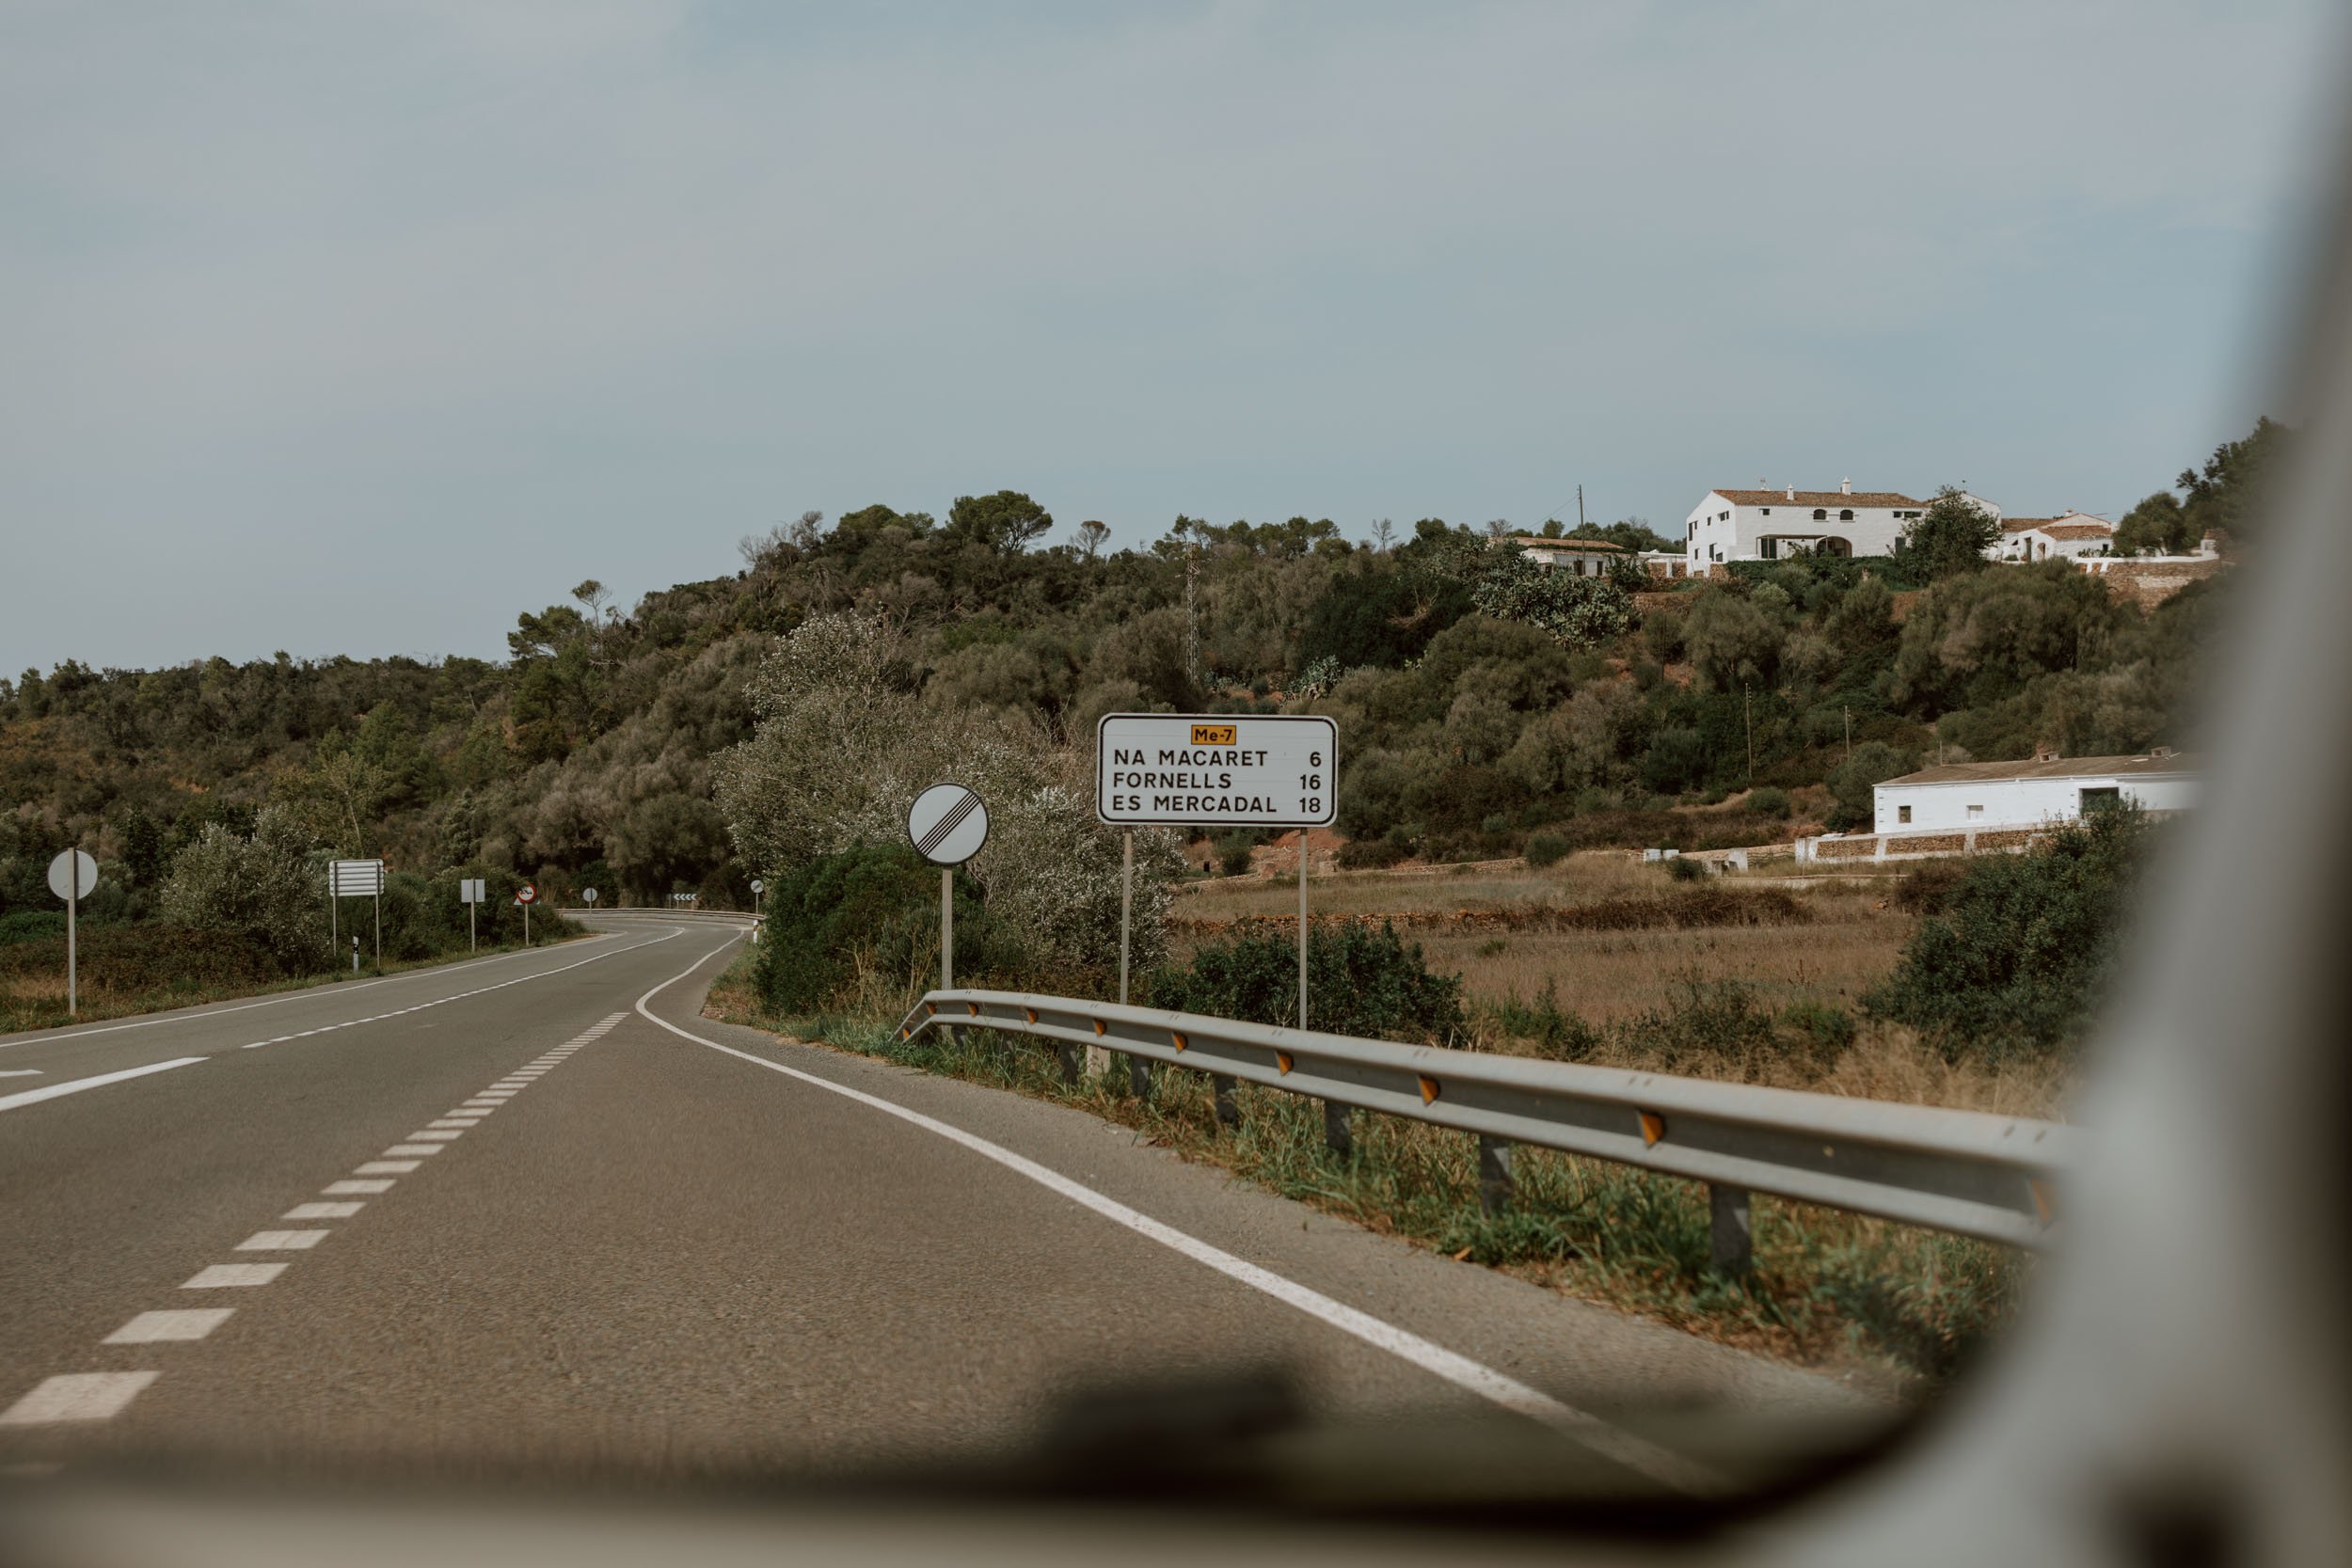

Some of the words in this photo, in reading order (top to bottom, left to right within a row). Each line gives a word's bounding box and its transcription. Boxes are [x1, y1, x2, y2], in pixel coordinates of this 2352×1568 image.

[1194, 728, 1233, 742] Me-7
[1114, 749, 1146, 766] NA
[1158, 750, 1268, 767] MACARET
[1309, 752, 1322, 768] 6
[1113, 772, 1232, 789] FORNELLS
[1299, 774, 1322, 790] 16
[1112, 795, 1141, 812] ES
[1153, 796, 1278, 813] MERCADAL
[1299, 797, 1321, 814] 18
